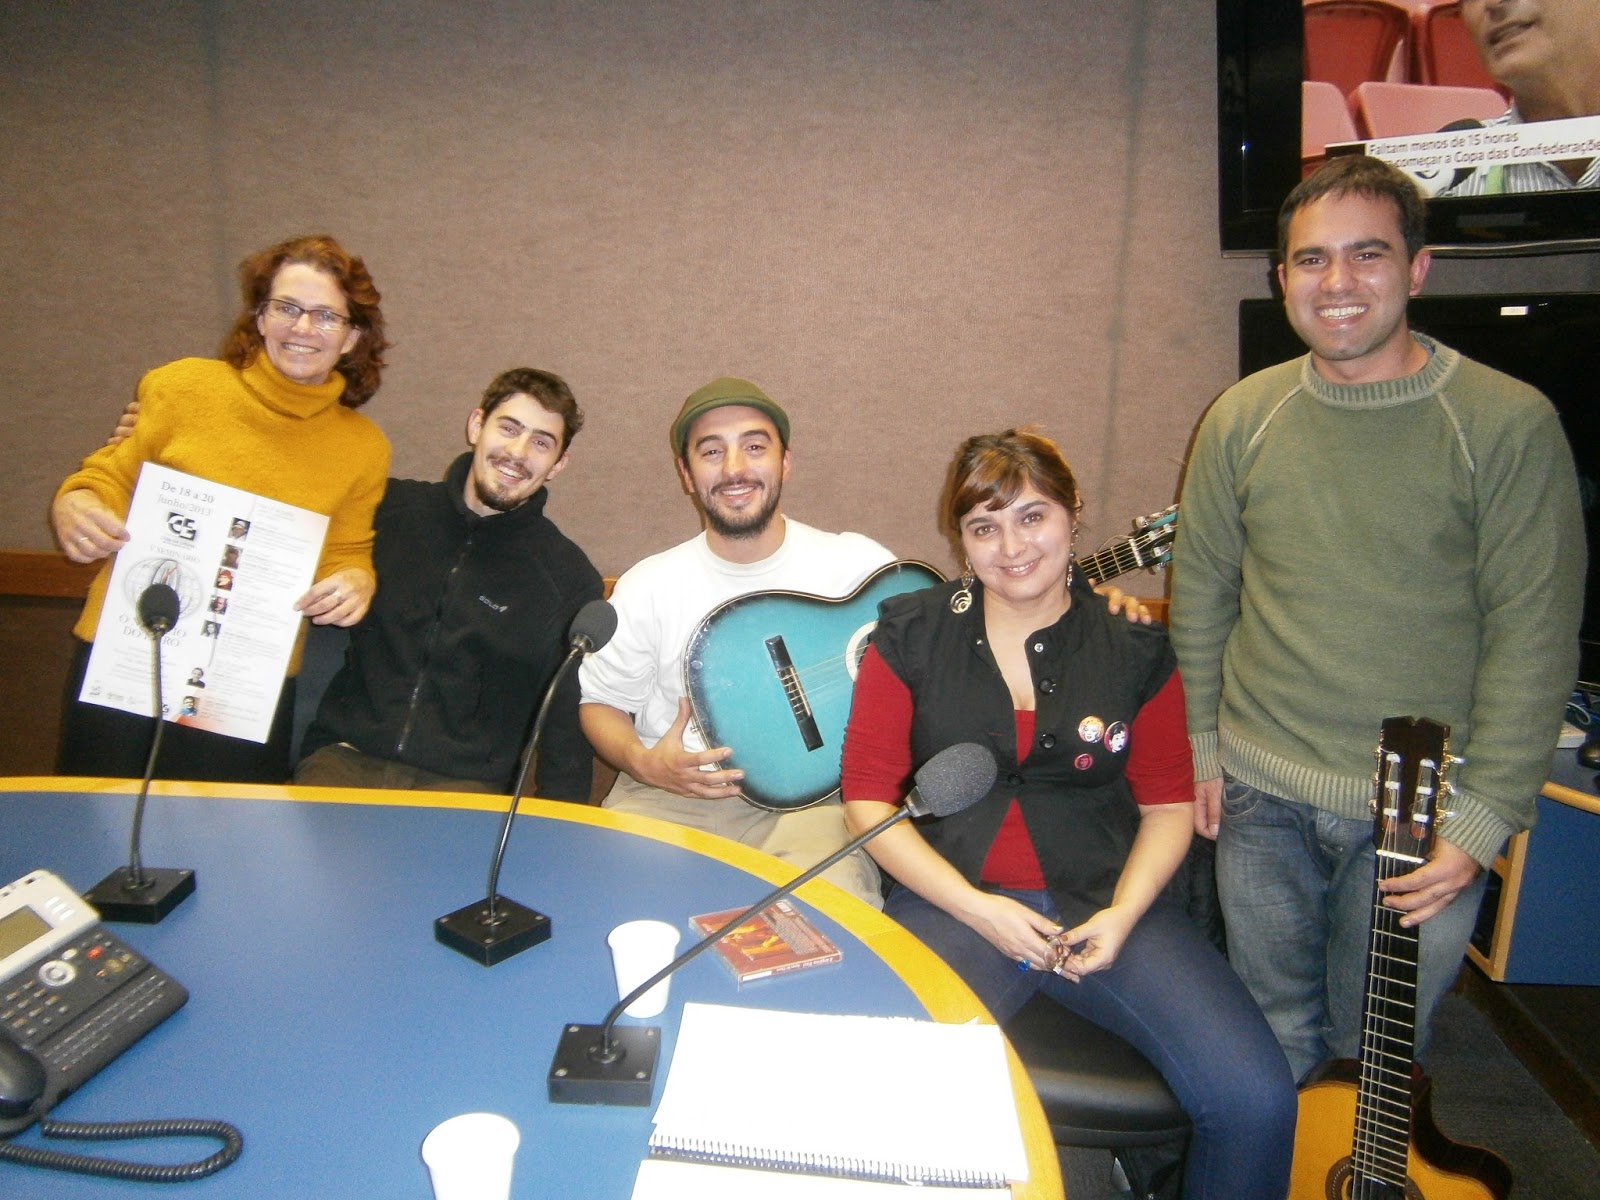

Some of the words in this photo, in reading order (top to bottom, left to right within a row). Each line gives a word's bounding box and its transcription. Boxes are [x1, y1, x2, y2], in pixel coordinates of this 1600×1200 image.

[1370, 142, 1409, 155] Faltam
[1411, 141, 1448, 152] menos
[1451, 135, 1466, 148] de
[1468, 133, 1481, 146] 15
[1483, 131, 1519, 144] horas
[1393, 155, 1442, 168] começar
[1444, 154, 1452, 164] a
[1454, 151, 1485, 164] Copa
[1487, 147, 1509, 160] das
[1511, 139, 1600, 158] Confederaçõe
[161, 481, 177, 493] De
[179, 487, 191, 497] 18
[201, 493, 214, 504] 20
[123, 625, 142, 638] DO
